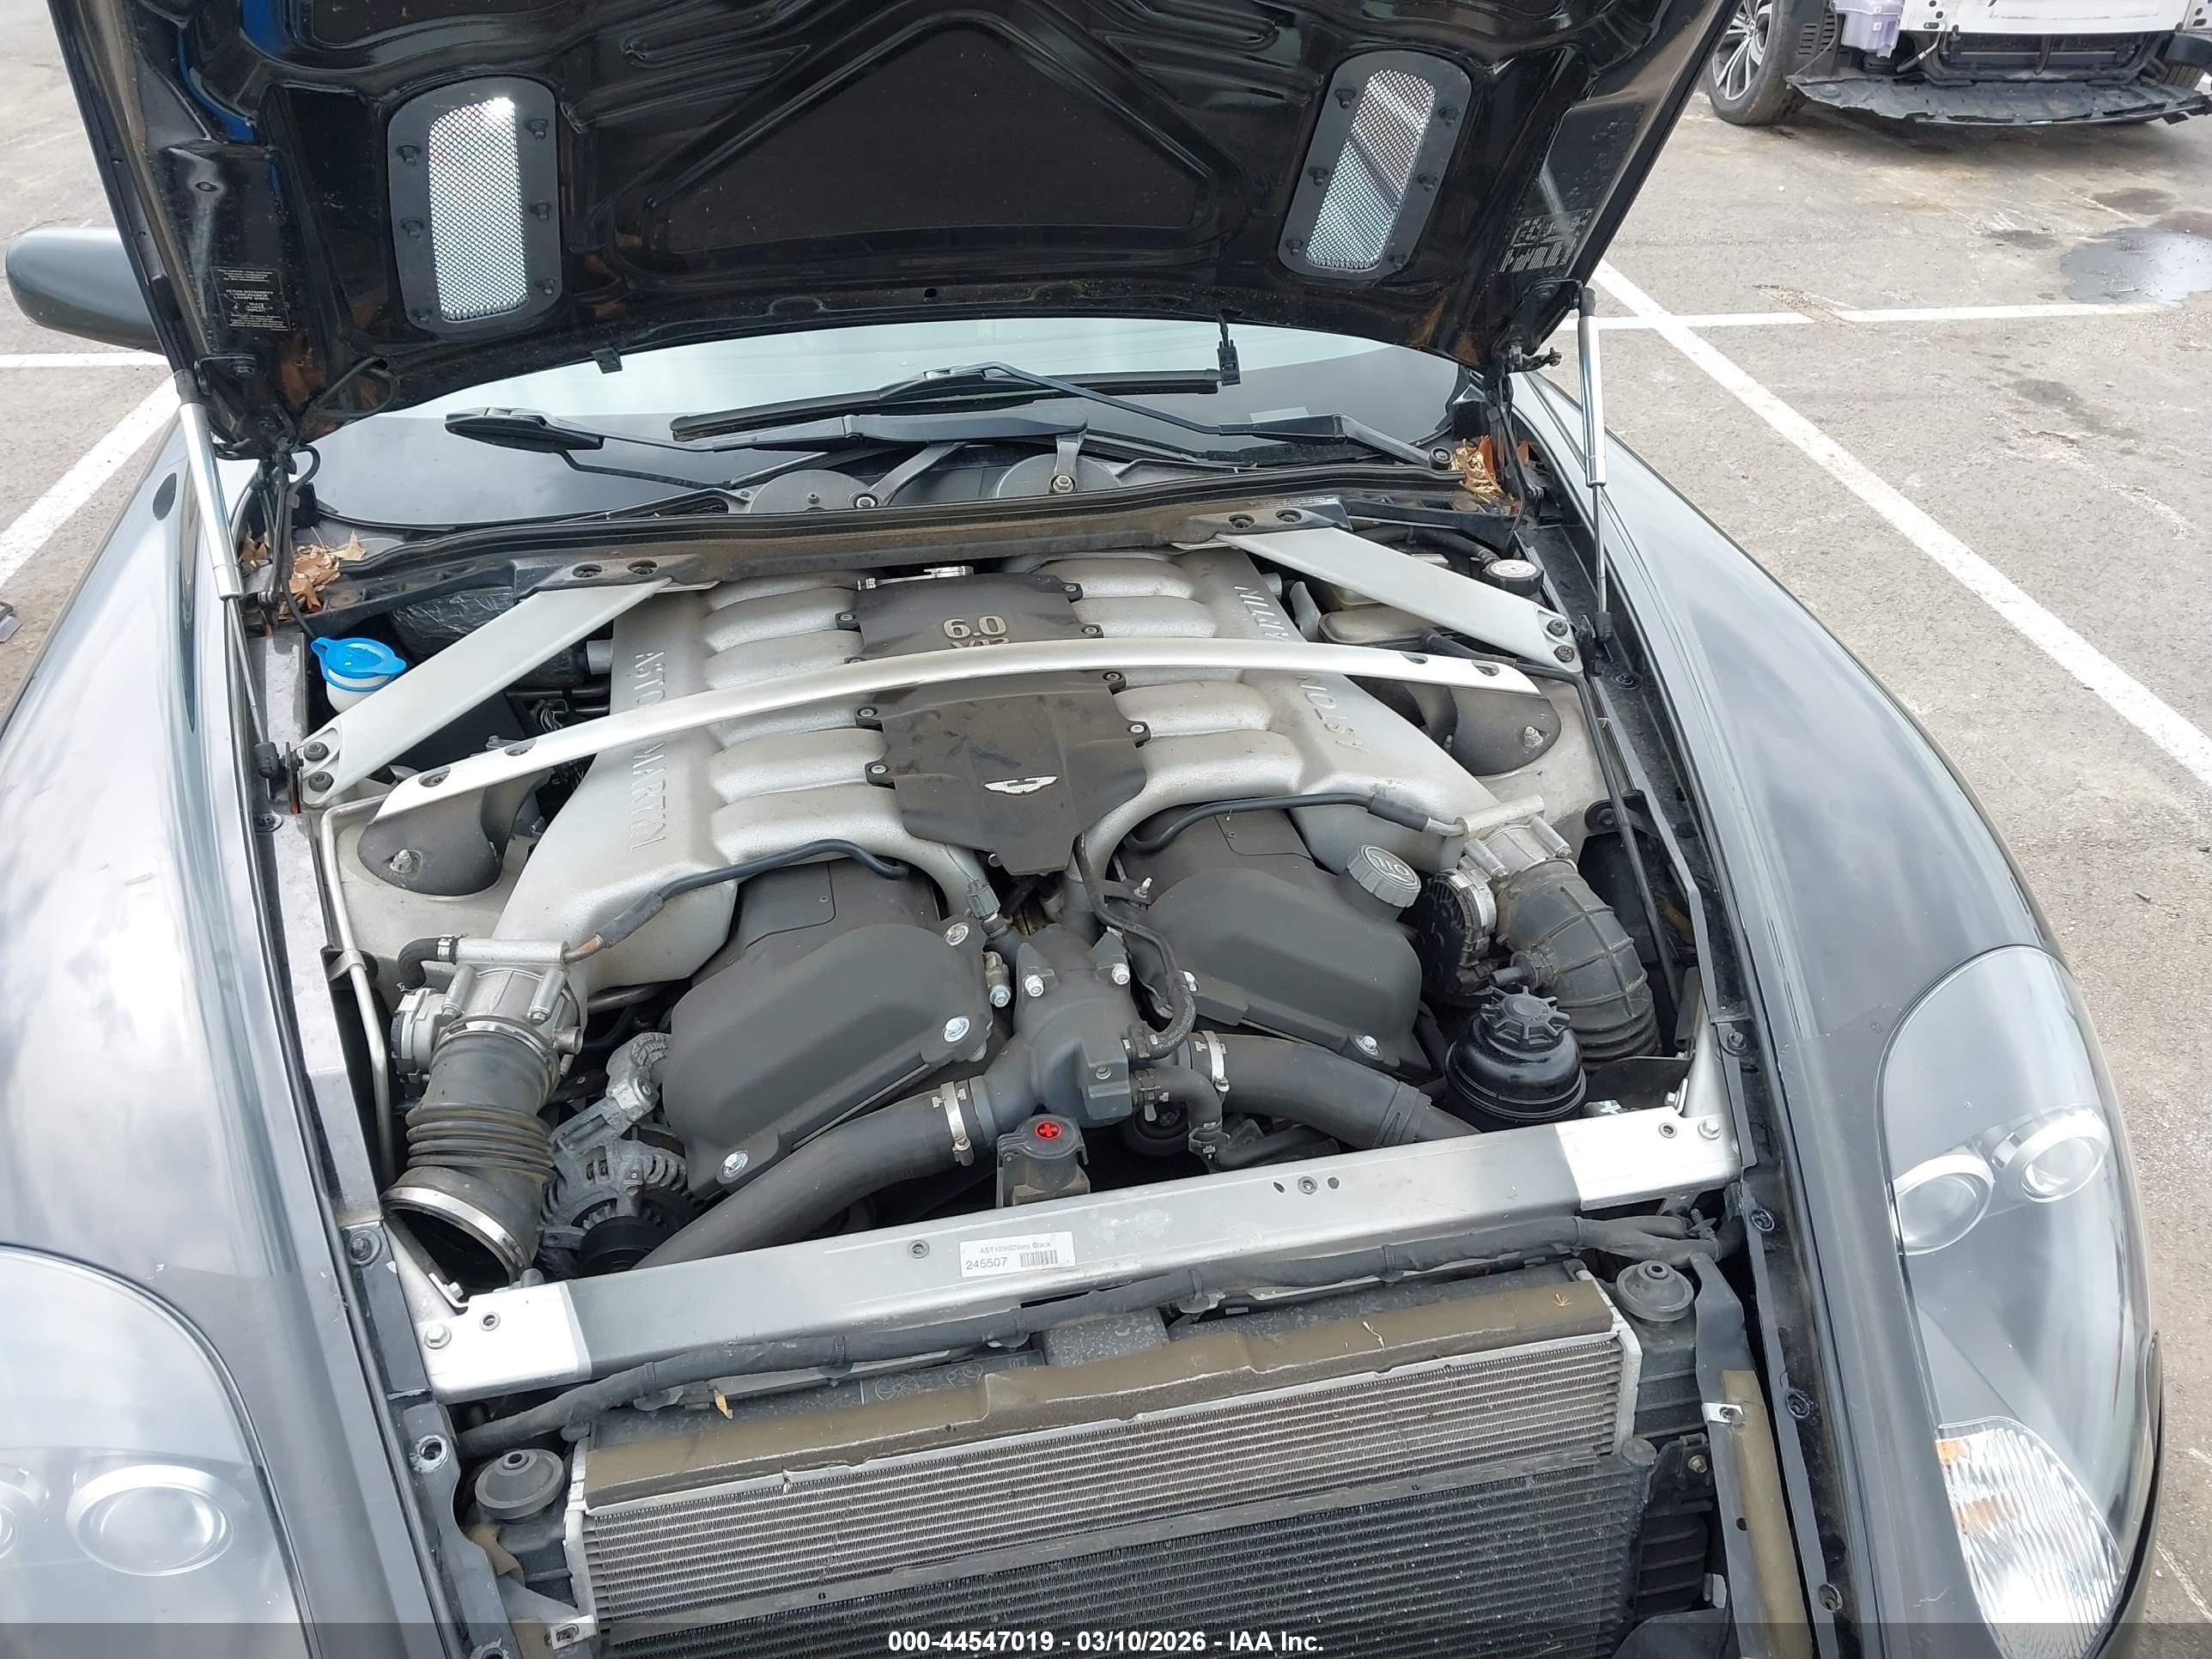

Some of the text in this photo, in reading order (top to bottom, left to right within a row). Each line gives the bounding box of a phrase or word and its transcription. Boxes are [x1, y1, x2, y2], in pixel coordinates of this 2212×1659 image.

[943, 615, 1007, 639] 6.0
[630, 651, 666, 852] ASTO MARTIN
